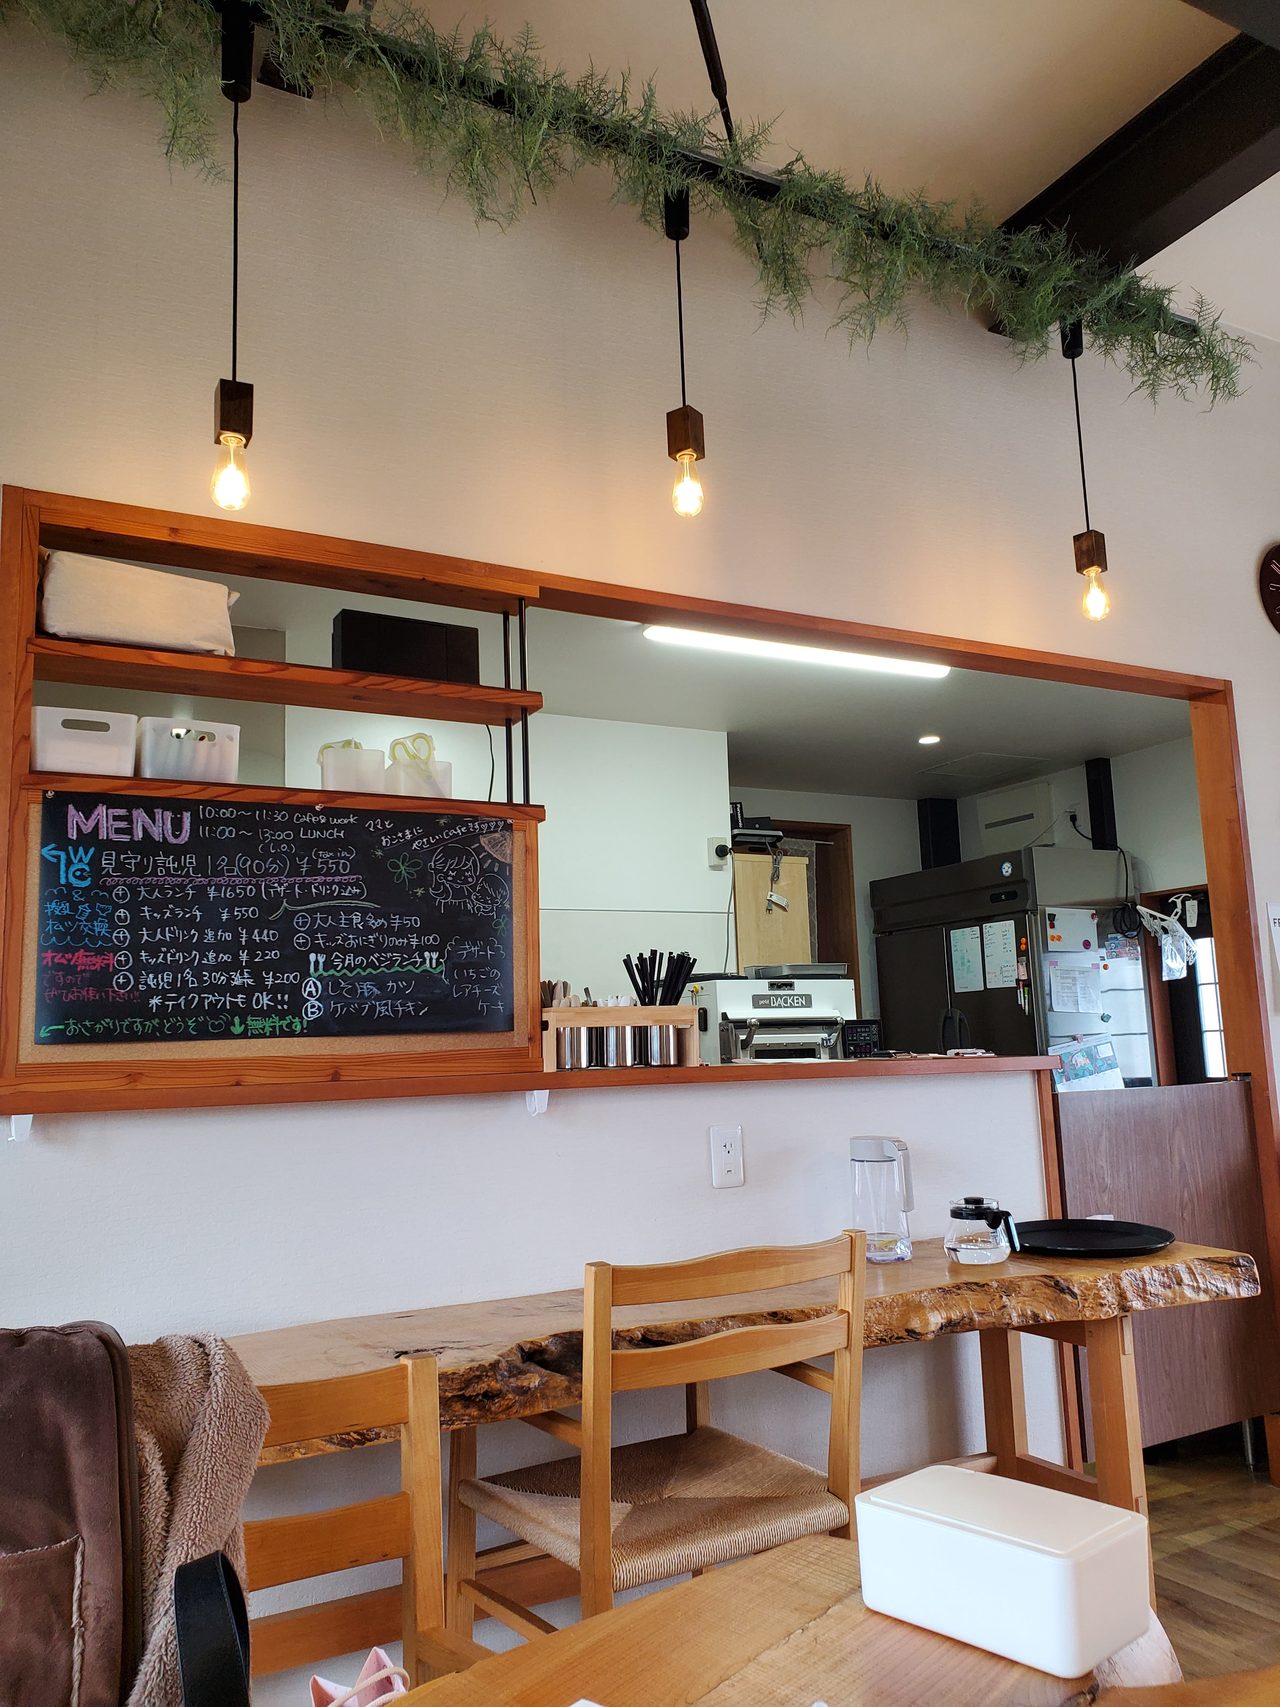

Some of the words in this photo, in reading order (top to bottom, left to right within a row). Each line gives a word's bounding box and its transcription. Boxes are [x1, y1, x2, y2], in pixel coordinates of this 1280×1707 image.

[67, 803, 191, 844] MENU
[300, 827, 344, 839] LUNCH
[138, 884, 197, 901] 大人ランチ
[207, 885, 256, 901] ¥1650
[139, 905, 203, 922] キッズランチ
[220, 906, 259, 921] ¥550
[45, 918, 111, 937] オムツ交換
[239, 927, 279, 945] ¥440
[239, 950, 280, 965] ¥220
[458, 941, 496, 960] デザート
[331, 952, 423, 970] 今月のベジランチ
[264, 971, 301, 989] ¥200
[454, 967, 501, 981] いちごの
[452, 984, 504, 998] レアチーズ
[330, 1000, 429, 1019] ケバブ風チキン
[478, 999, 504, 1016] ケーキ
[771, 996, 805, 1007] BACKEN
